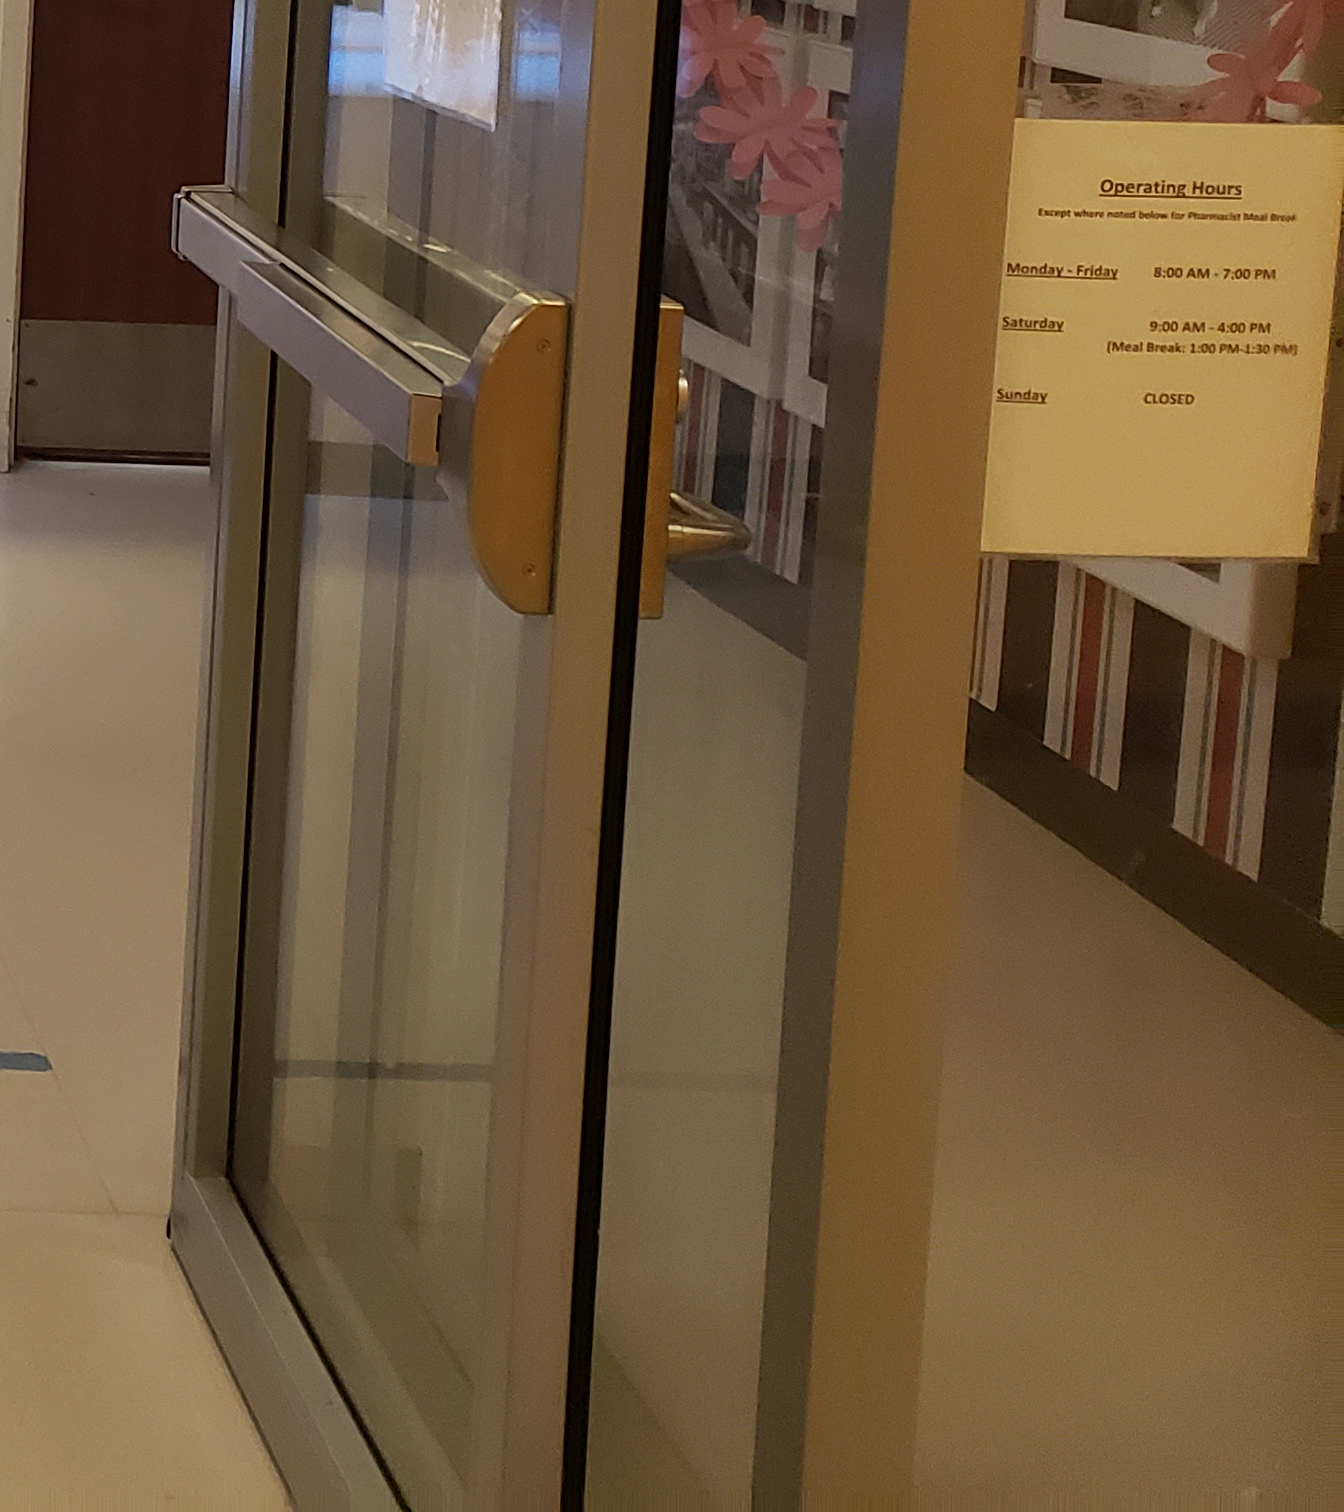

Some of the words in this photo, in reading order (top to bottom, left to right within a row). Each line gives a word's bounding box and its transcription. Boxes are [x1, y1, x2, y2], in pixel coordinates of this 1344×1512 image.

[1099, 178, 1187, 197] Operating
[1192, 180, 1243, 198] Hours
[1038, 207, 1071, 219] Except
[1074, 209, 1105, 219] where
[1107, 209, 1136, 219] noted
[1138, 210, 1168, 220] below
[1170, 211, 1186, 221] for
[1188, 211, 1241, 222] Pharmacist
[1243, 212, 1268, 222] Meal
[1006, 262, 1064, 277] Monday
[1076, 264, 1119, 279] Friday
[1153, 266, 1184, 279] 8:00
[1187, 268, 1211, 279] AM
[1223, 268, 1251, 280] 7:00
[1254, 268, 1277, 280] PM
[1002, 316, 1065, 331] Saturday
[1149, 321, 1180, 334] 9:00
[1183, 321, 1207, 334] AM
[1217, 322, 1246, 334] 4:00
[1250, 322, 1272, 334] PM
[1106, 341, 1144, 355] (Meal
[1146, 341, 1187, 355] Break:
[1190, 342, 1217, 354] 1:00
[996, 388, 1048, 403] Sunday
[1143, 392, 1195, 405] CLOSED
